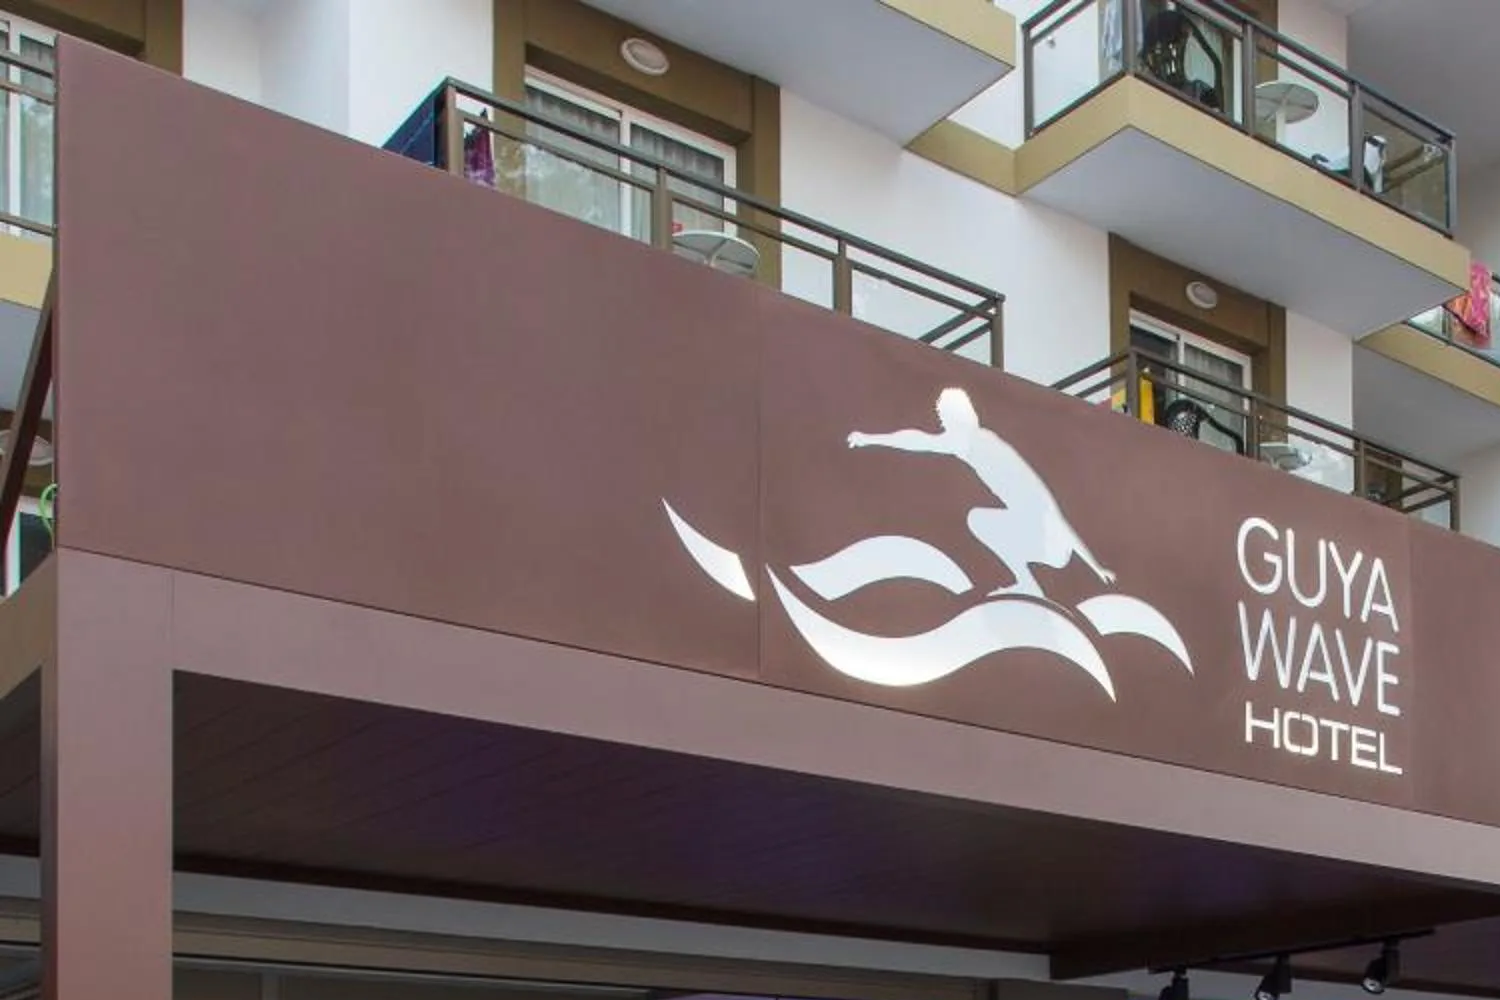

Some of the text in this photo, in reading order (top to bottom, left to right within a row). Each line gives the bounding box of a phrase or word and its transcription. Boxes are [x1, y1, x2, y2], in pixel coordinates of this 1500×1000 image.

[1237, 517, 1399, 632] GUYA
[1238, 600, 1400, 716] WAVE
[1245, 701, 1402, 775] HOTEL
